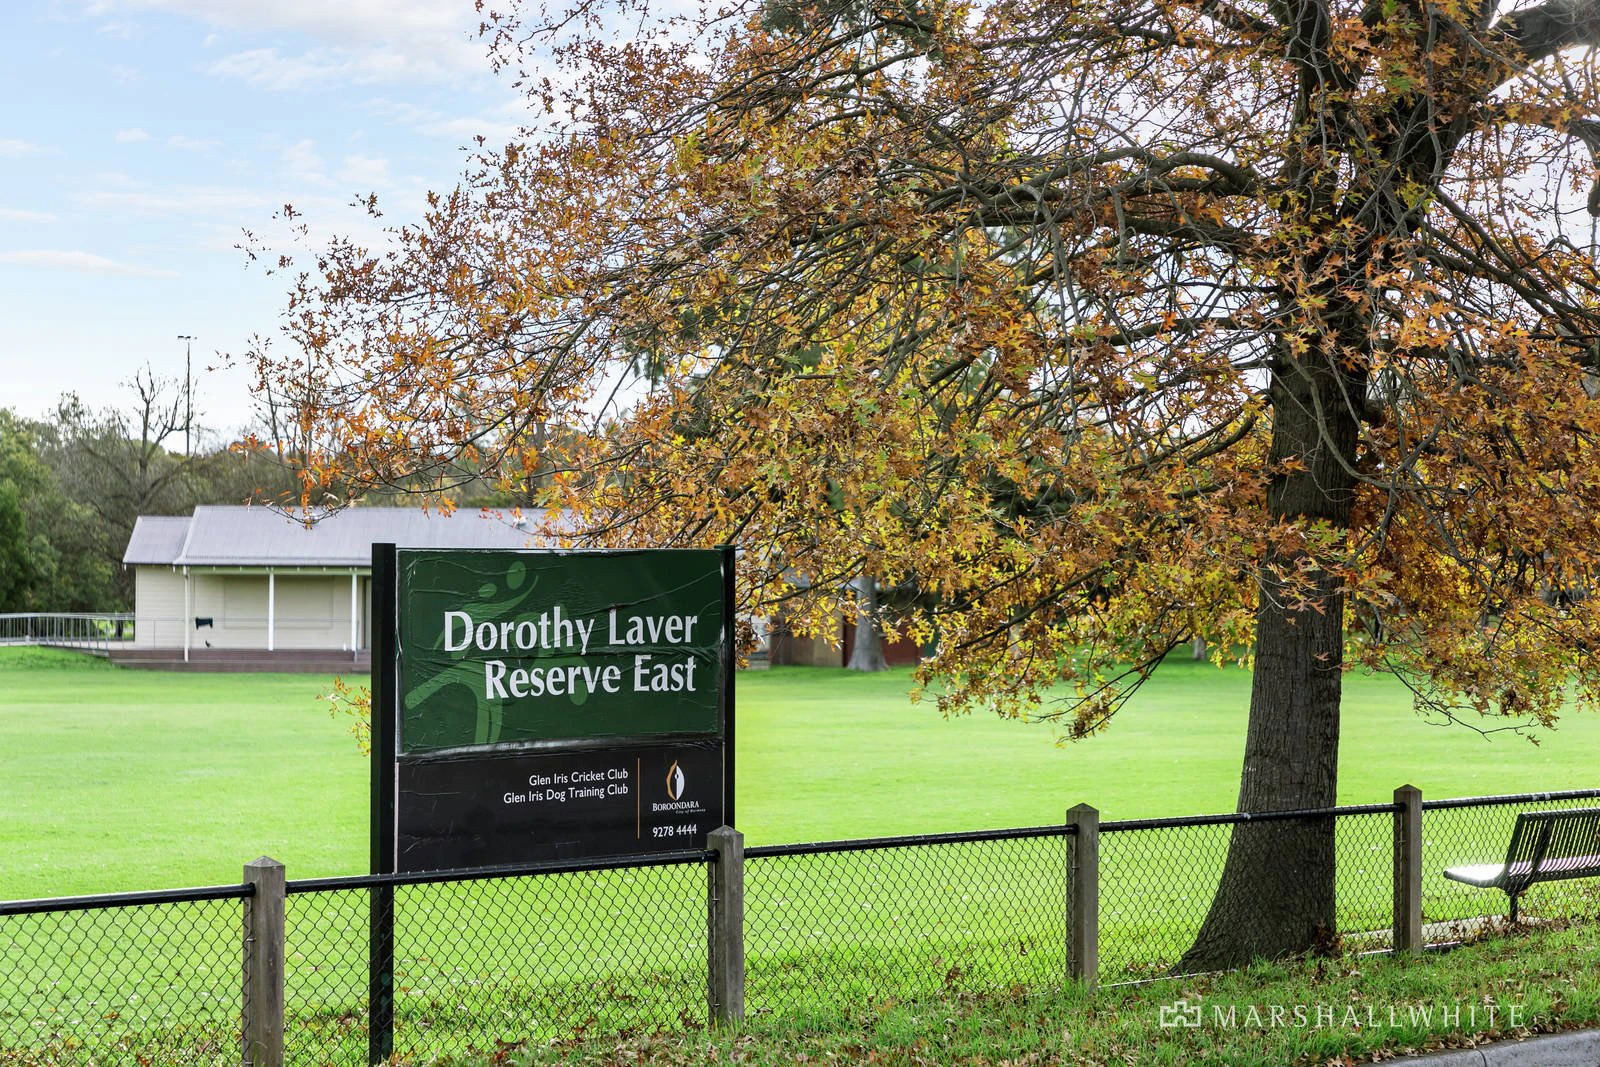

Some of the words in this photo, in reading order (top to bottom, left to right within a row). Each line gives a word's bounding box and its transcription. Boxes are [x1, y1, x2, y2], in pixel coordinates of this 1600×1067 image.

[444, 606, 594, 655] Dorothy
[608, 608, 698, 645] Laver
[485, 660, 621, 699] Reserve
[633, 654, 697, 692] East
[529, 774, 551, 786] Glen
[554, 772, 568, 784] Iris
[571, 770, 605, 783] Cricket
[607, 768, 628, 780] Club
[503, 792, 526, 804] Glen
[529, 788, 543, 801] Iris
[546, 787, 566, 801] Dog
[568, 786, 605, 799] Training
[607, 783, 628, 795] Club
[652, 801, 700, 812] BOROONDARA
[652, 826, 674, 837] 9278
[676, 824, 697, 835] 4444
